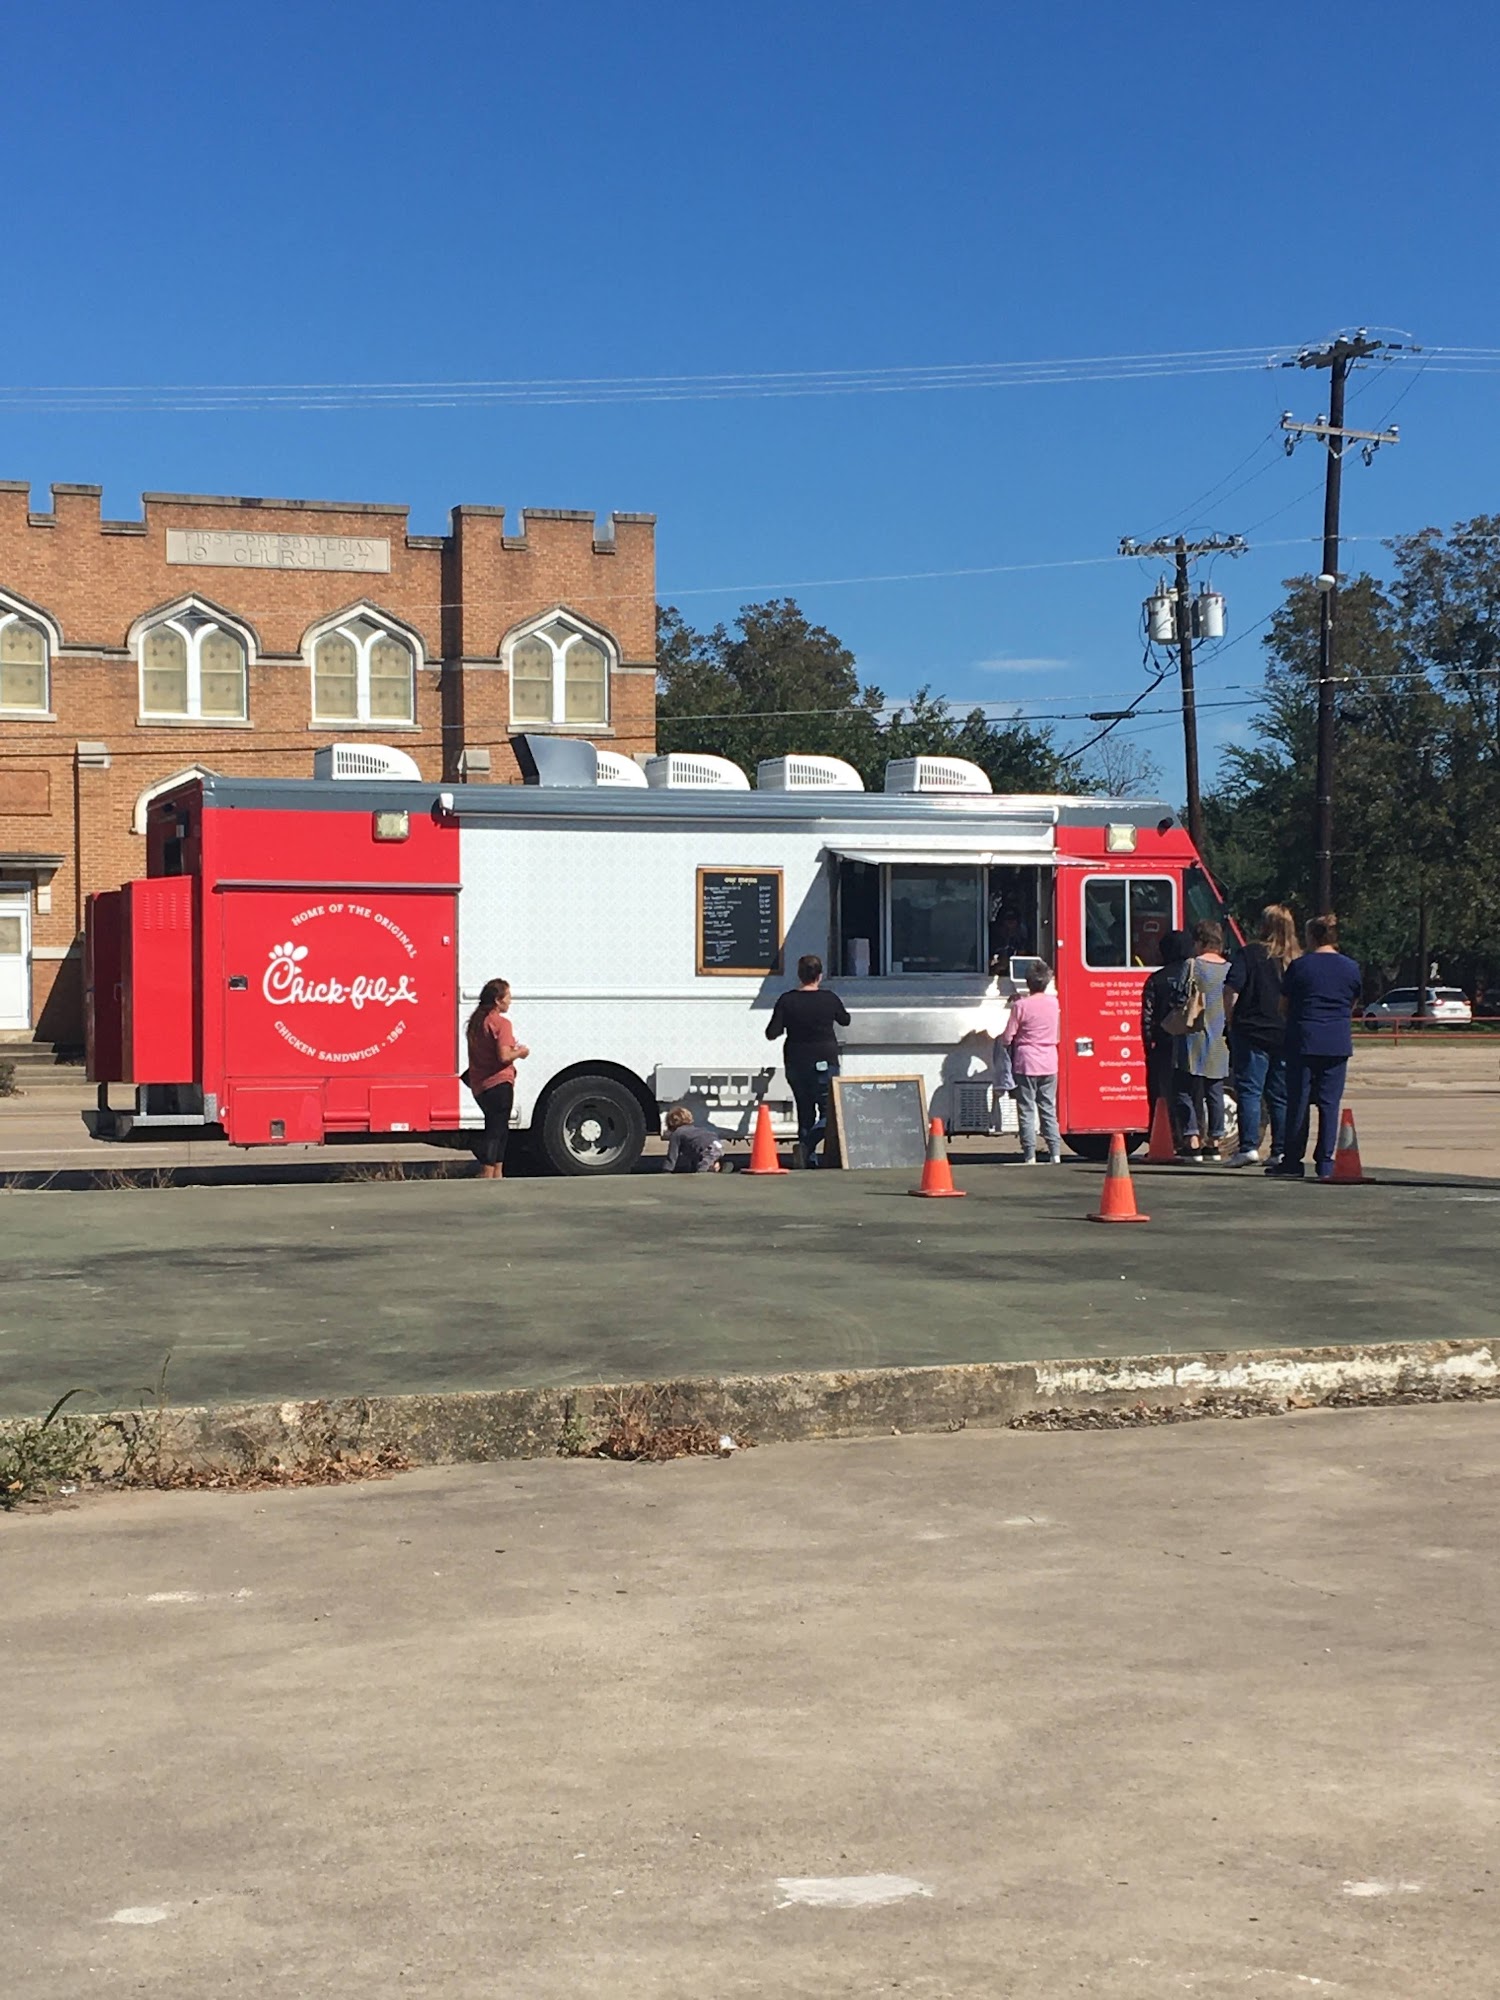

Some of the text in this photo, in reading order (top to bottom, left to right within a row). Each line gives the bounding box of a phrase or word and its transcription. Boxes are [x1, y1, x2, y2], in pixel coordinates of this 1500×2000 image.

[186, 546, 369, 568] 19 CHURCH 27
[291, 904, 417, 958] HOME OF THE ORIGINAL
[262, 955, 418, 1010] Chick-fil-A
[274, 1020, 407, 1063] CHICKEN SANDWICH 1967
